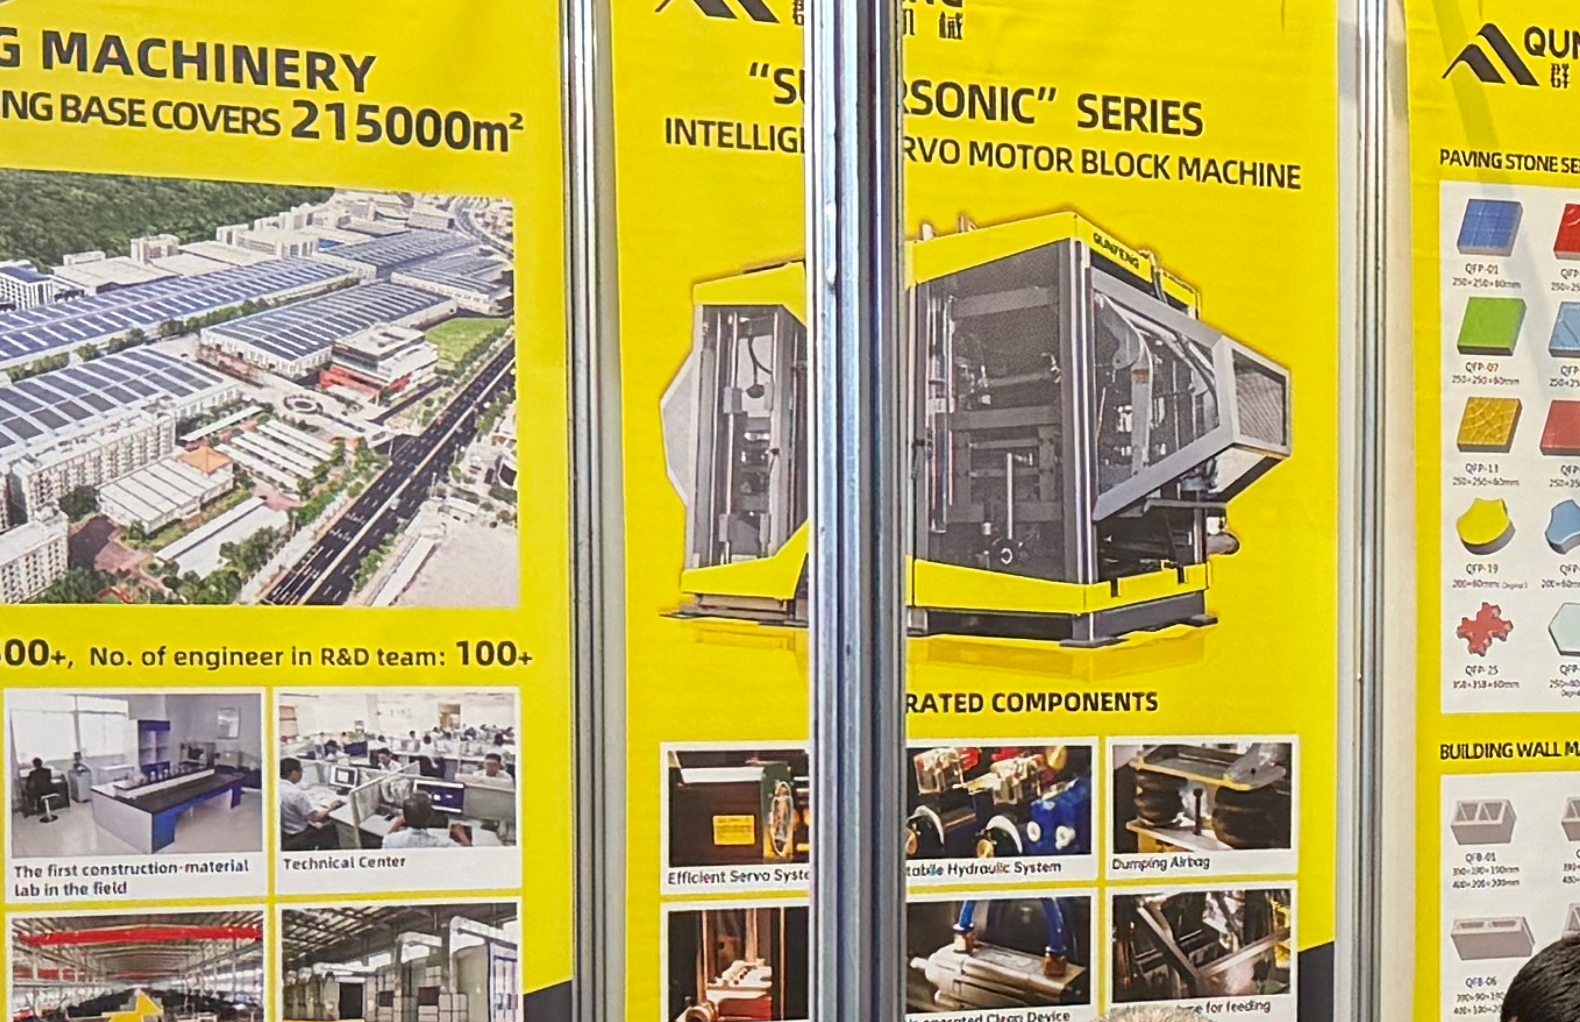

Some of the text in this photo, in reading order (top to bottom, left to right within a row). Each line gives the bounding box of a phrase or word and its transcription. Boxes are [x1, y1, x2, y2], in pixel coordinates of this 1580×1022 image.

[42, 29, 376, 93] MACHINERY
[60, 94, 147, 128] BASE
[152, 101, 281, 137] COVERS
[1076, 92, 1204, 138] SERIES
[902, 136, 961, 165] RVO
[968, 140, 1074, 175] MOTOR
[1081, 150, 1171, 181] BLOCK
[1177, 155, 1302, 191] MACHINE
[1439, 148, 1503, 170] PAVING
[1504, 152, 1559, 174] STONE
[0, 638, 533, 671] 00+, No. of engineer in R&D team: 100+
[905, 690, 1159, 714] RATED COMPONENTS
[1440, 741, 1514, 760] BUILDING
[1516, 742, 1561, 759] WALL
[14, 859, 249, 878] The first construction-material
[283, 855, 406, 870] Technical Center
[947, 861, 1010, 877] Hydraulic
[1014, 860, 1061, 876] System
[1111, 855, 1210, 872] Dumping Airbag
[668, 867, 811, 885] Efficient Servo Syste
[44, 882, 59, 896] in
[63, 882, 88, 896] the
[93, 881, 127, 895] field
[1205, 1001, 1224, 1014] for
[1226, 1000, 1272, 1015] feeding
